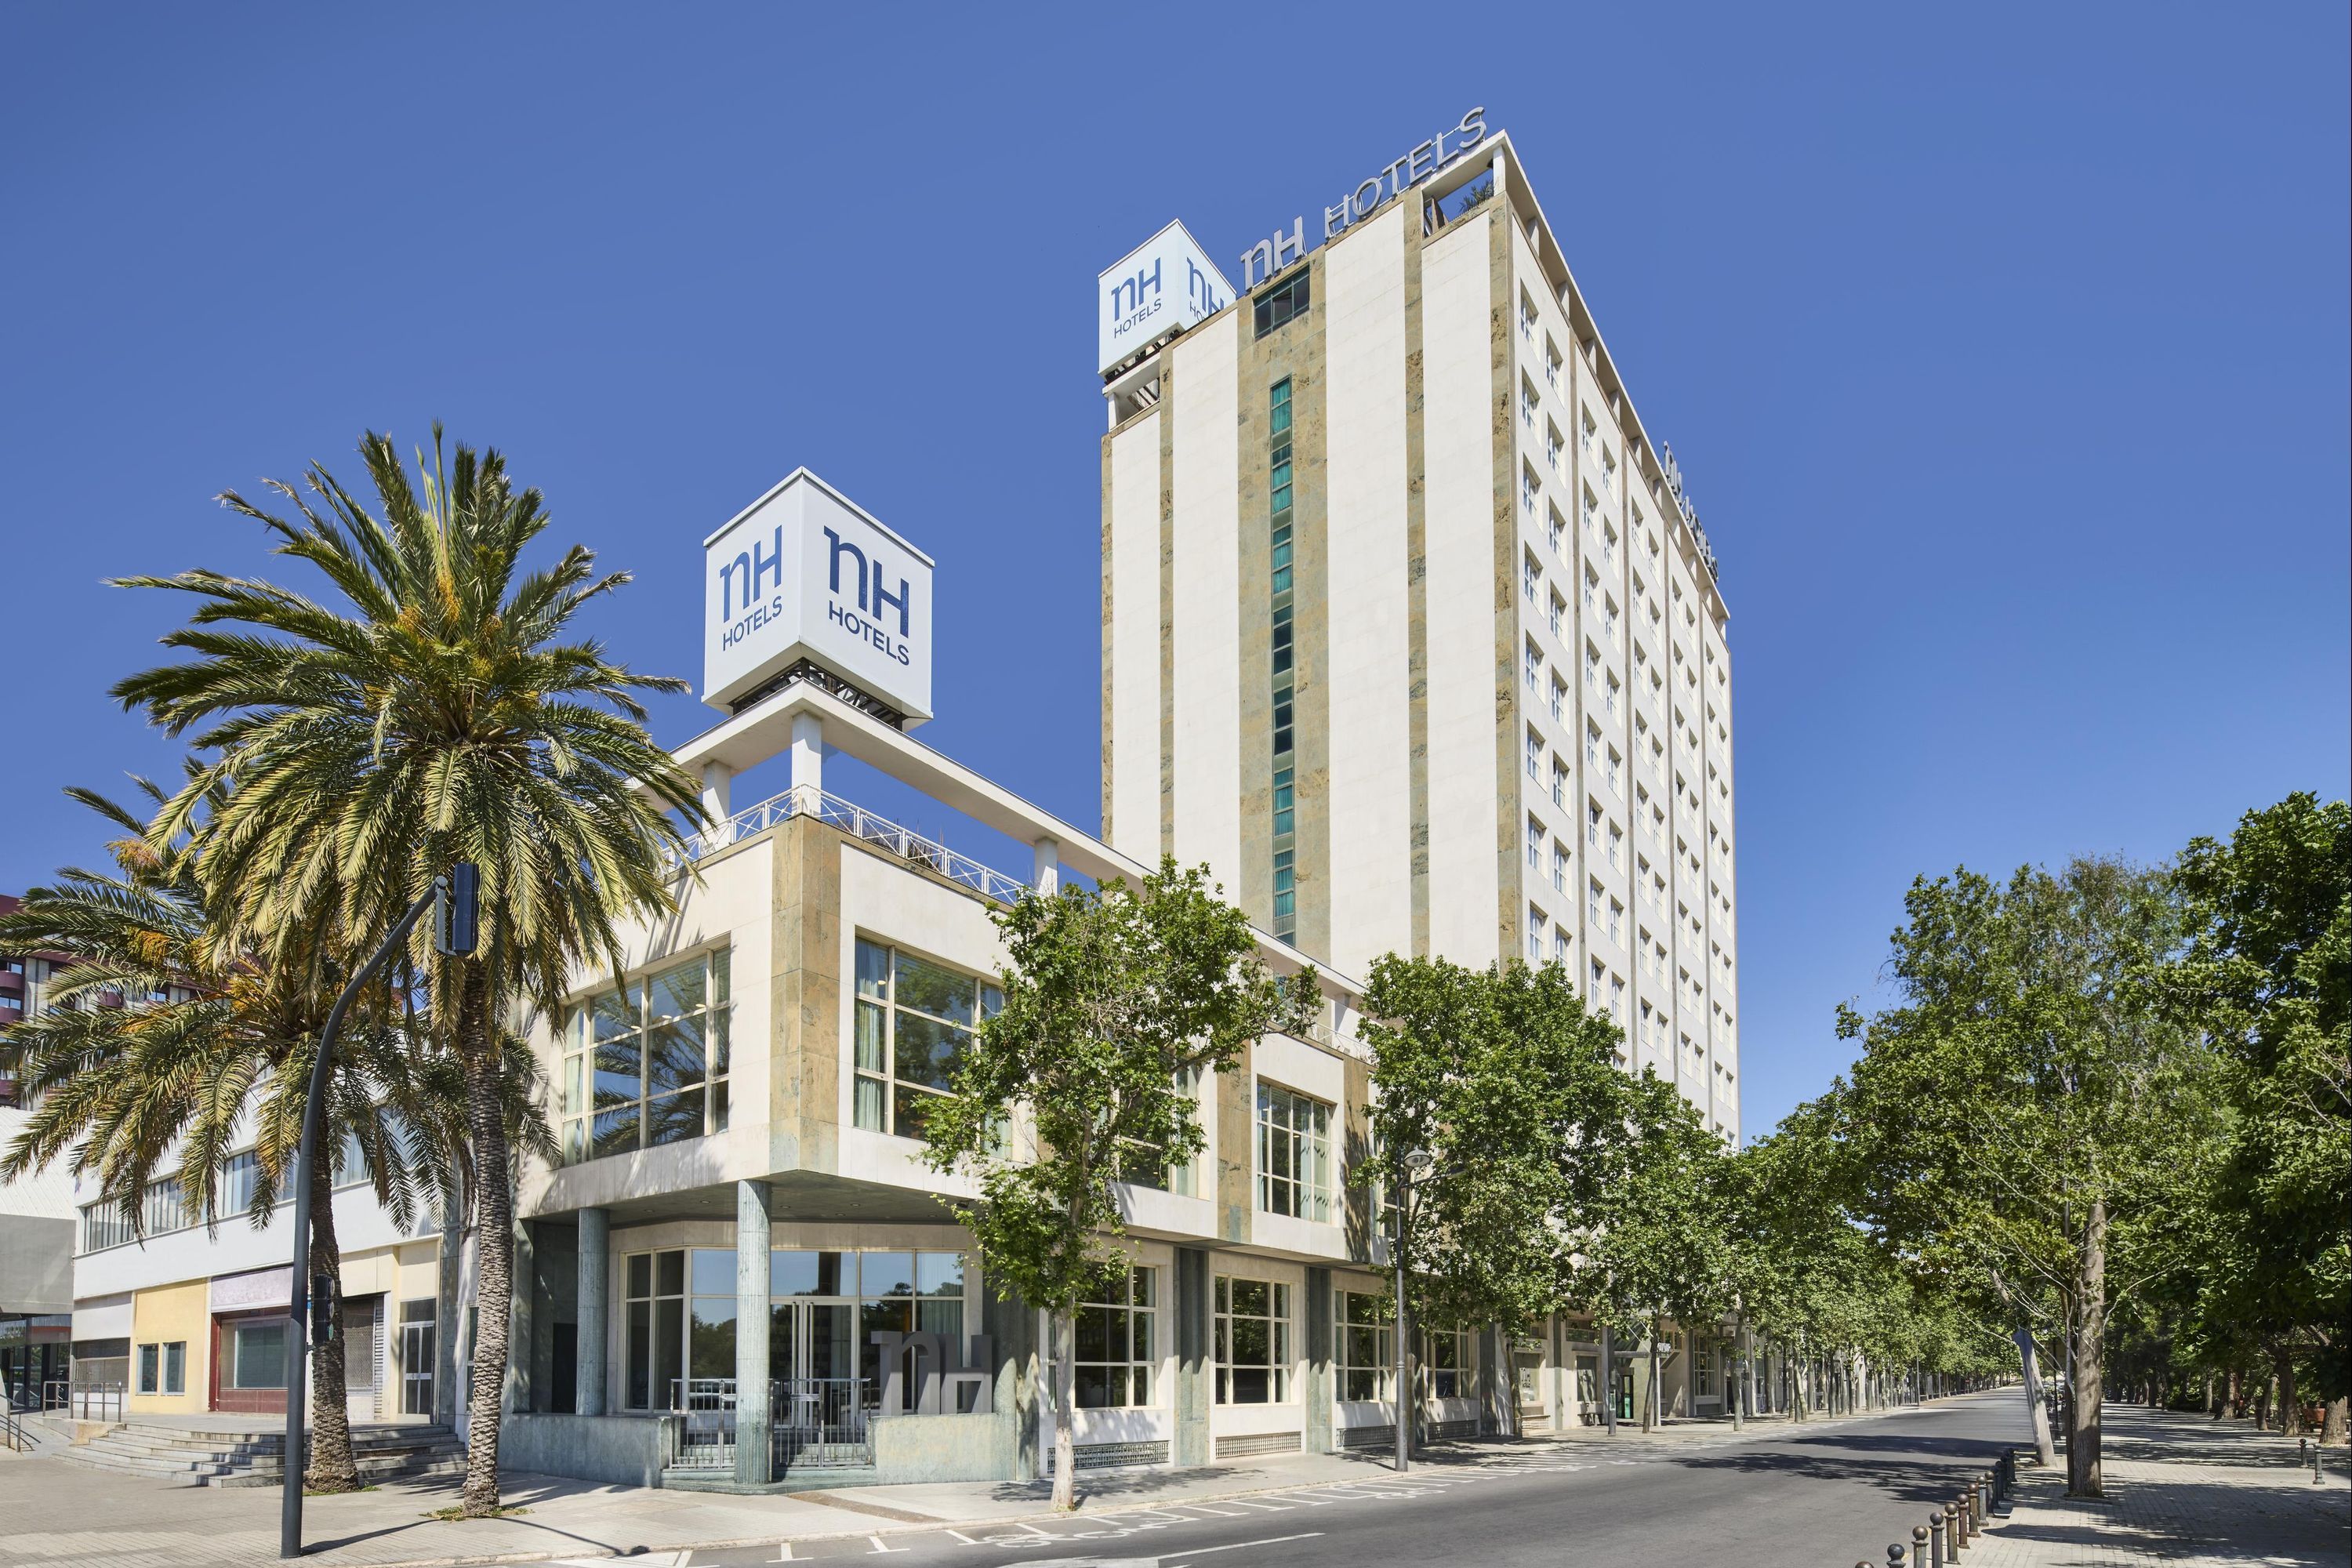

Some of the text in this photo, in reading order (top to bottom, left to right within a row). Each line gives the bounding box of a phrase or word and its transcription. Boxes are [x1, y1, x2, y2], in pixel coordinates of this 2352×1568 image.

[1324, 107, 1486, 240] HOTELS
[1111, 256, 1161, 321] nH
[1114, 298, 1162, 339] HOTELS
[720, 524, 782, 623] nH
[824, 525, 909, 638] nH
[723, 595, 782, 652] HOTELS
[829, 600, 910, 666] HOTELS
